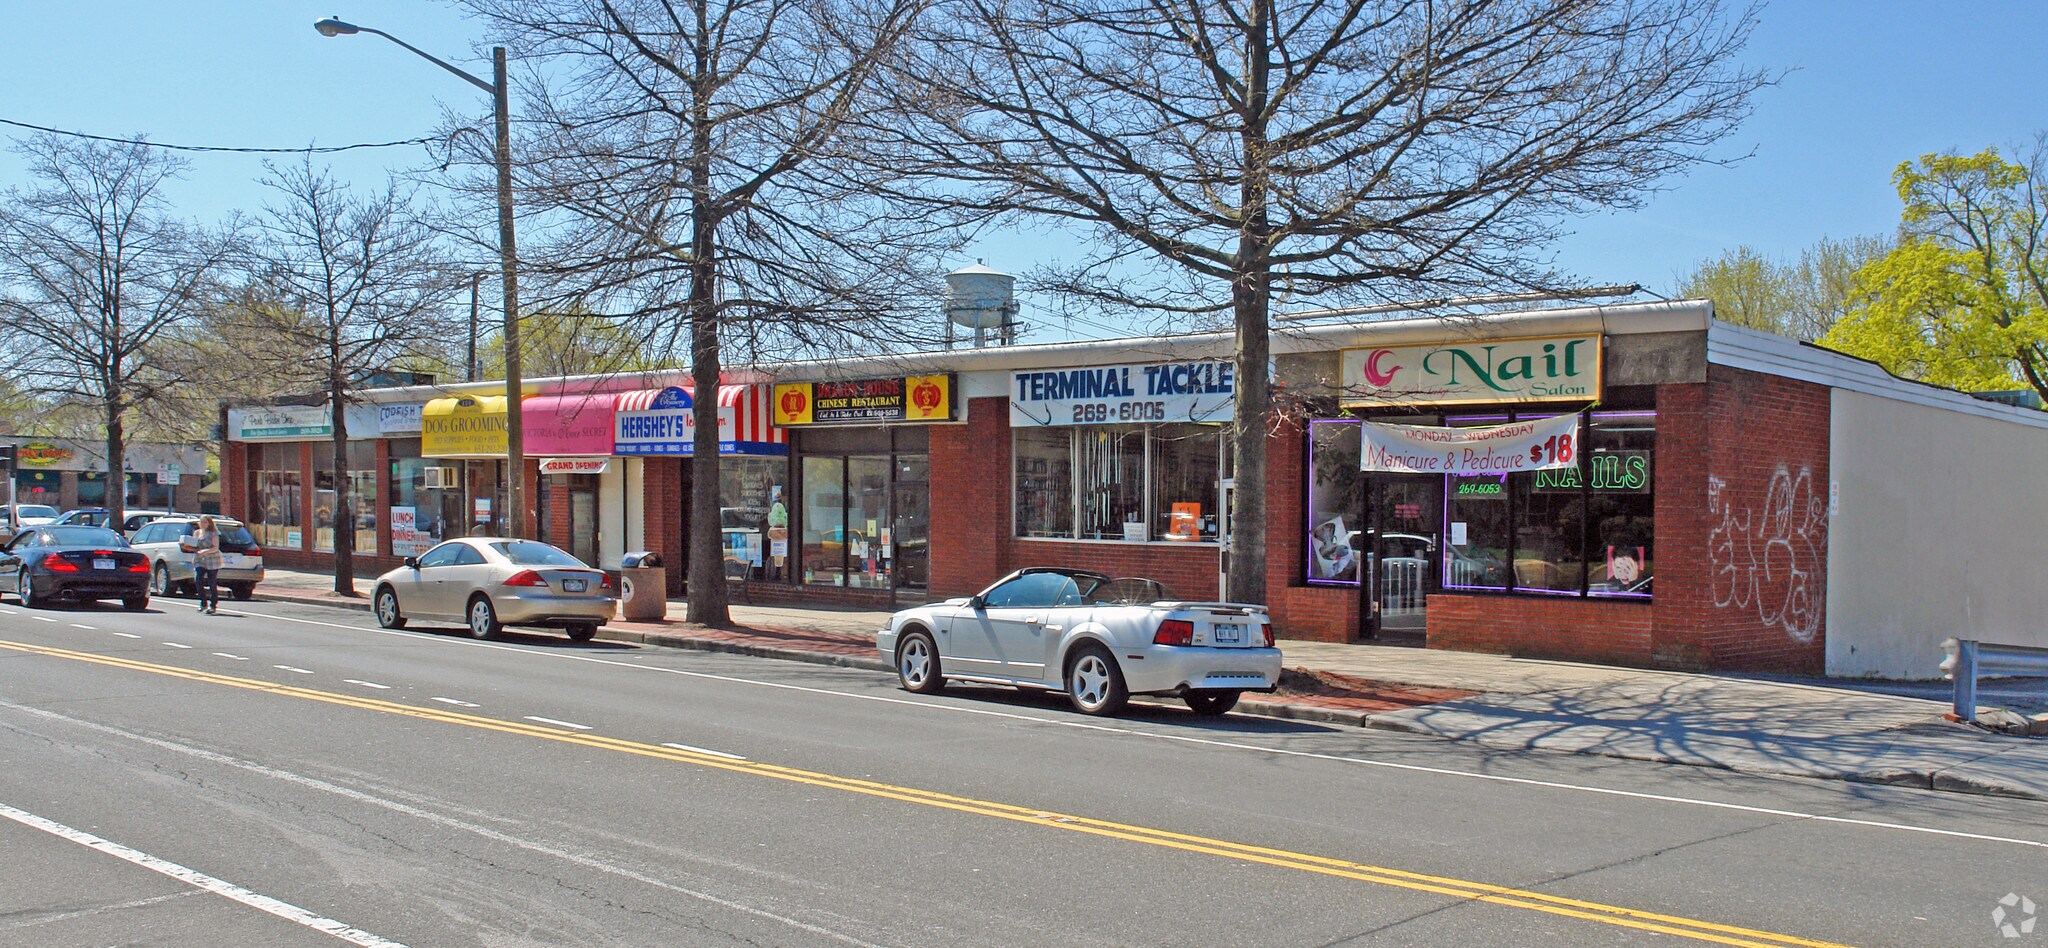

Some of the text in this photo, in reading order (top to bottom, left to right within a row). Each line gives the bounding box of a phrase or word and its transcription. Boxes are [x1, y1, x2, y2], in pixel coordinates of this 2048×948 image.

[1423, 339, 1587, 392] Nail
[817, 380, 899, 397] DRAGON HOUSE
[1016, 363, 1233, 401] TERMINAL TACKLE
[1529, 381, 1587, 396] Salon
[817, 396, 900, 408] CHINESE RESTAURANT
[380, 406, 415, 421] CODFISH
[425, 419, 443, 433] DOG
[450, 417, 508, 432] GROOMING
[582, 427, 607, 436] SECRET
[622, 415, 683, 438] HERSHEY'S
[1405, 427, 1453, 442] MONDAY
[1467, 424, 1534, 440] WEDNESDAY
[1368, 434, 1573, 470] Manicure & Pedicure $18
[546, 462, 573, 470] GRAND
[1458, 484, 1500, 494] 269-6053
[392, 512, 414, 523] LUNCH
[392, 530, 416, 541] DINNER
